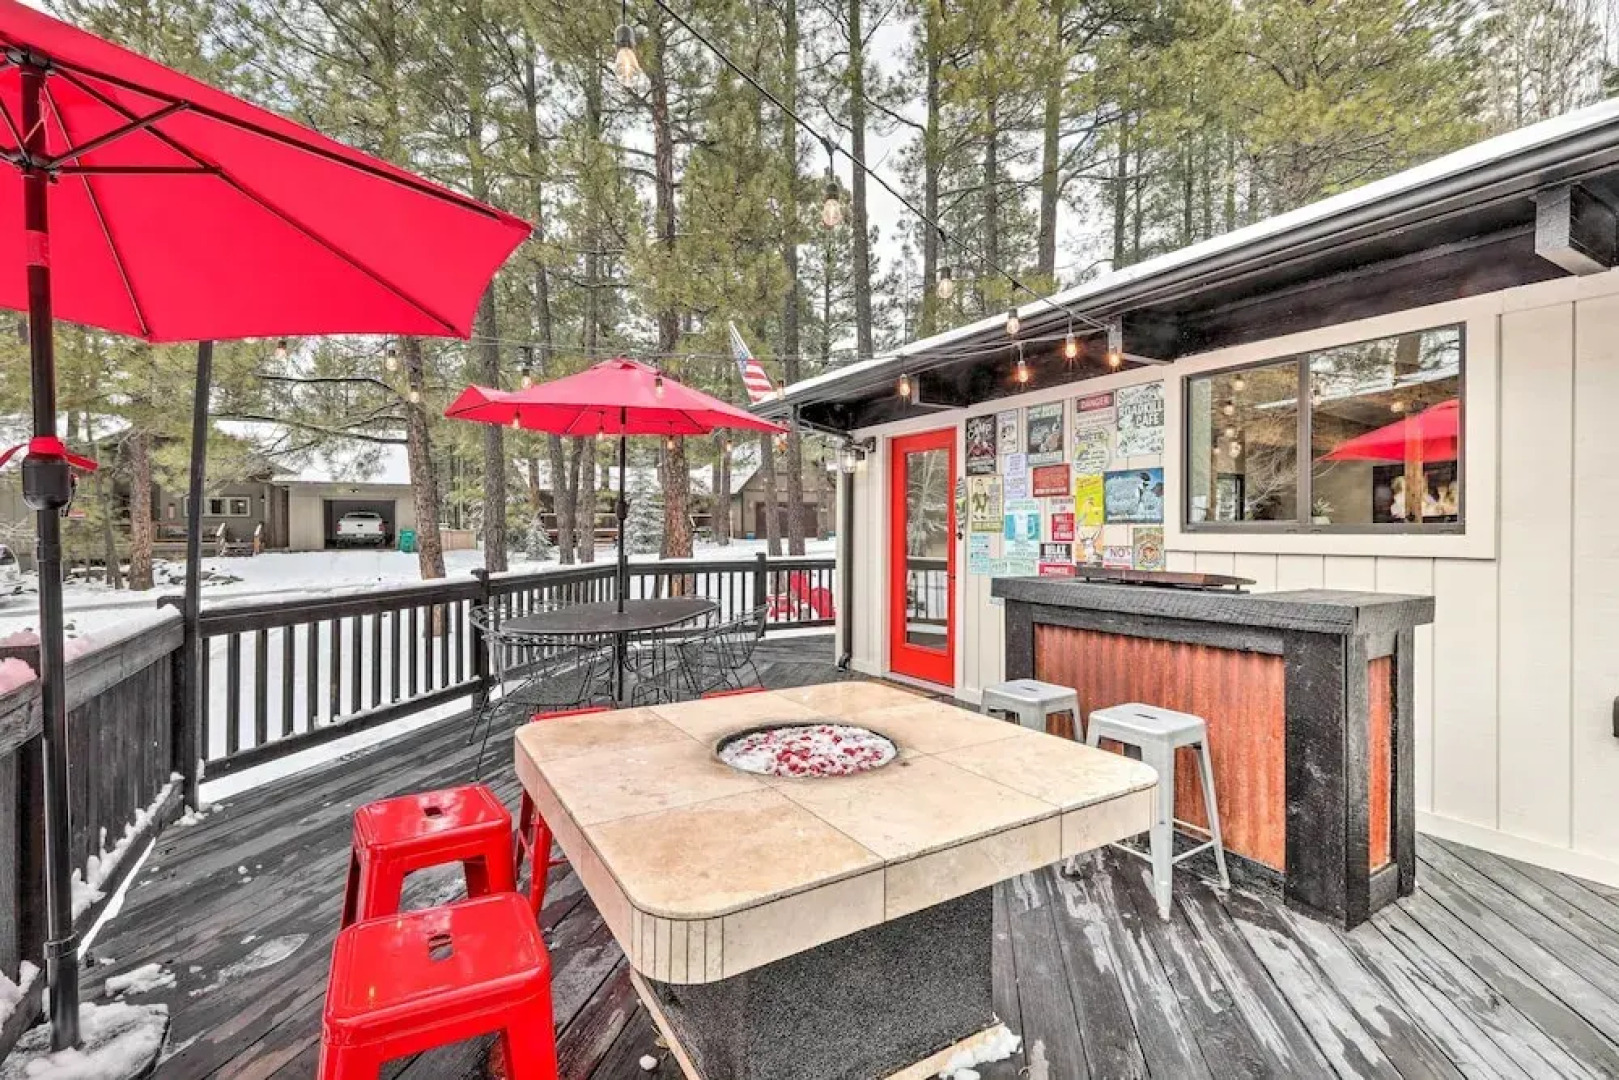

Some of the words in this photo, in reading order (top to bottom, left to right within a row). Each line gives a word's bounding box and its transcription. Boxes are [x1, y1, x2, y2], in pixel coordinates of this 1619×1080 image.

[1080, 394, 1110, 409] DANGER
[1135, 411, 1158, 426] CAFE
[967, 422, 992, 439] CAMP
